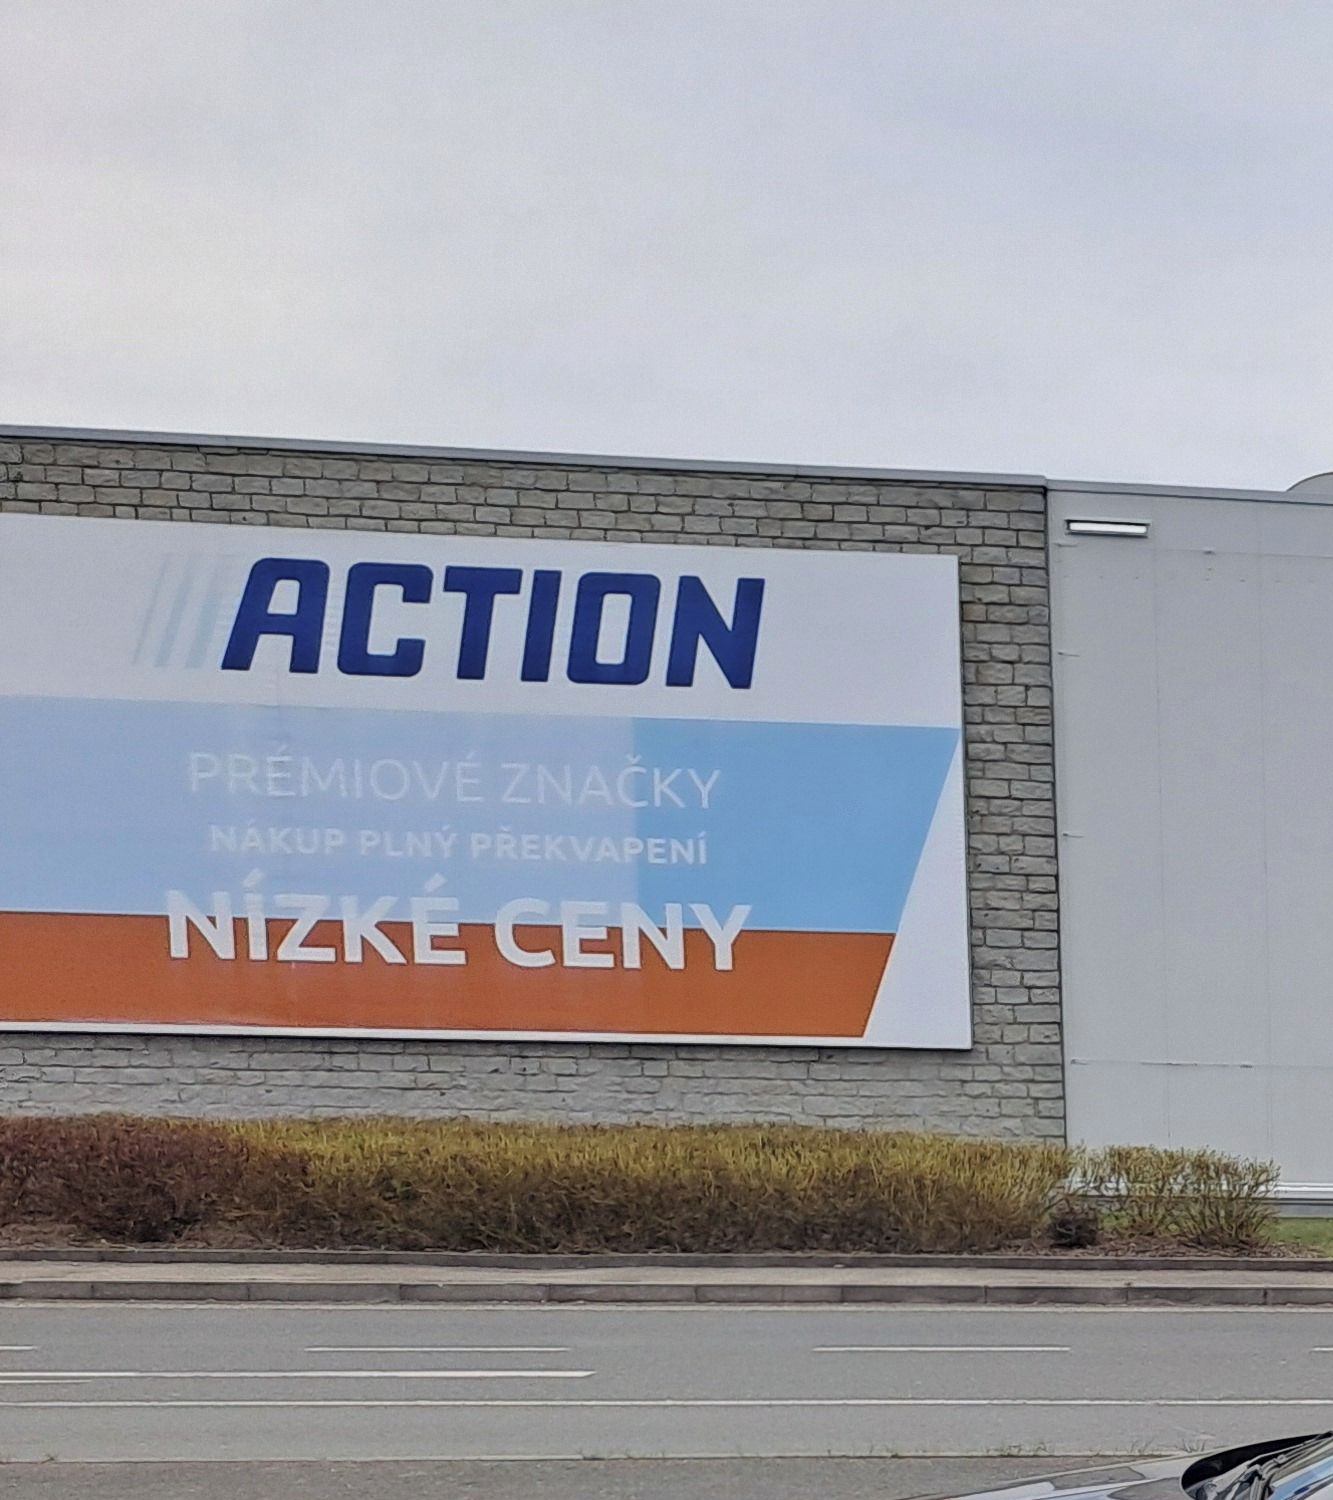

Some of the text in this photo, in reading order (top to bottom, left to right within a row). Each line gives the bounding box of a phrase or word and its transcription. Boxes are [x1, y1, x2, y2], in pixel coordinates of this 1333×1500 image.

[221, 556, 765, 689] ACTION
[189, 746, 721, 809] PRÉMIOVÉ ZNAČKY
[211, 818, 707, 866] NÁKUP PLNÝ PŘEKVAPENÍ
[166, 869, 752, 971] NÍZKÉ CENY
